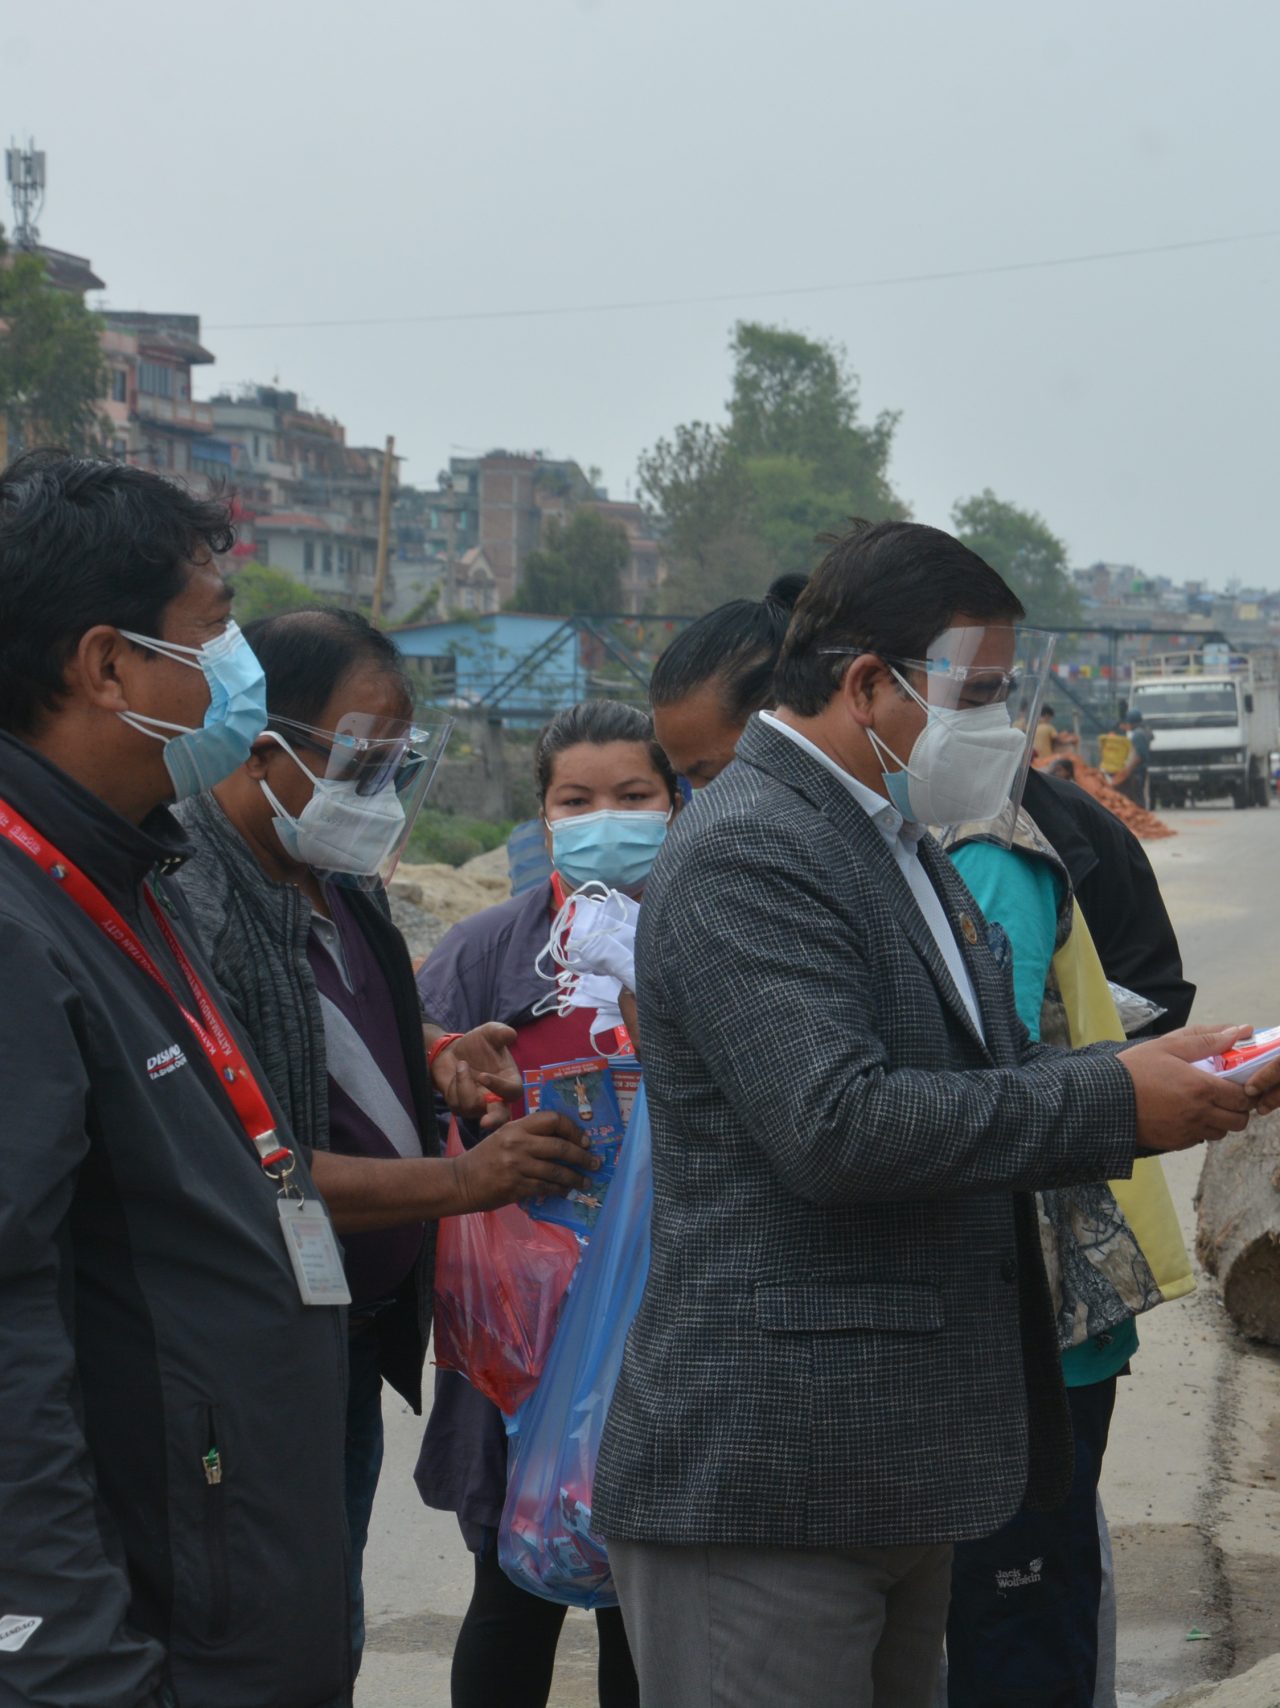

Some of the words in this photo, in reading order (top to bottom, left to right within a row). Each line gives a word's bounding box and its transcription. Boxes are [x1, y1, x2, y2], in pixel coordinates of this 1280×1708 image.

[101, 920, 125, 941] CITY
[200, 999, 233, 1057] KATHMANDU
[996, 1568, 1021, 1579] Jack
[998, 1573, 1041, 1588] Wolfskin
